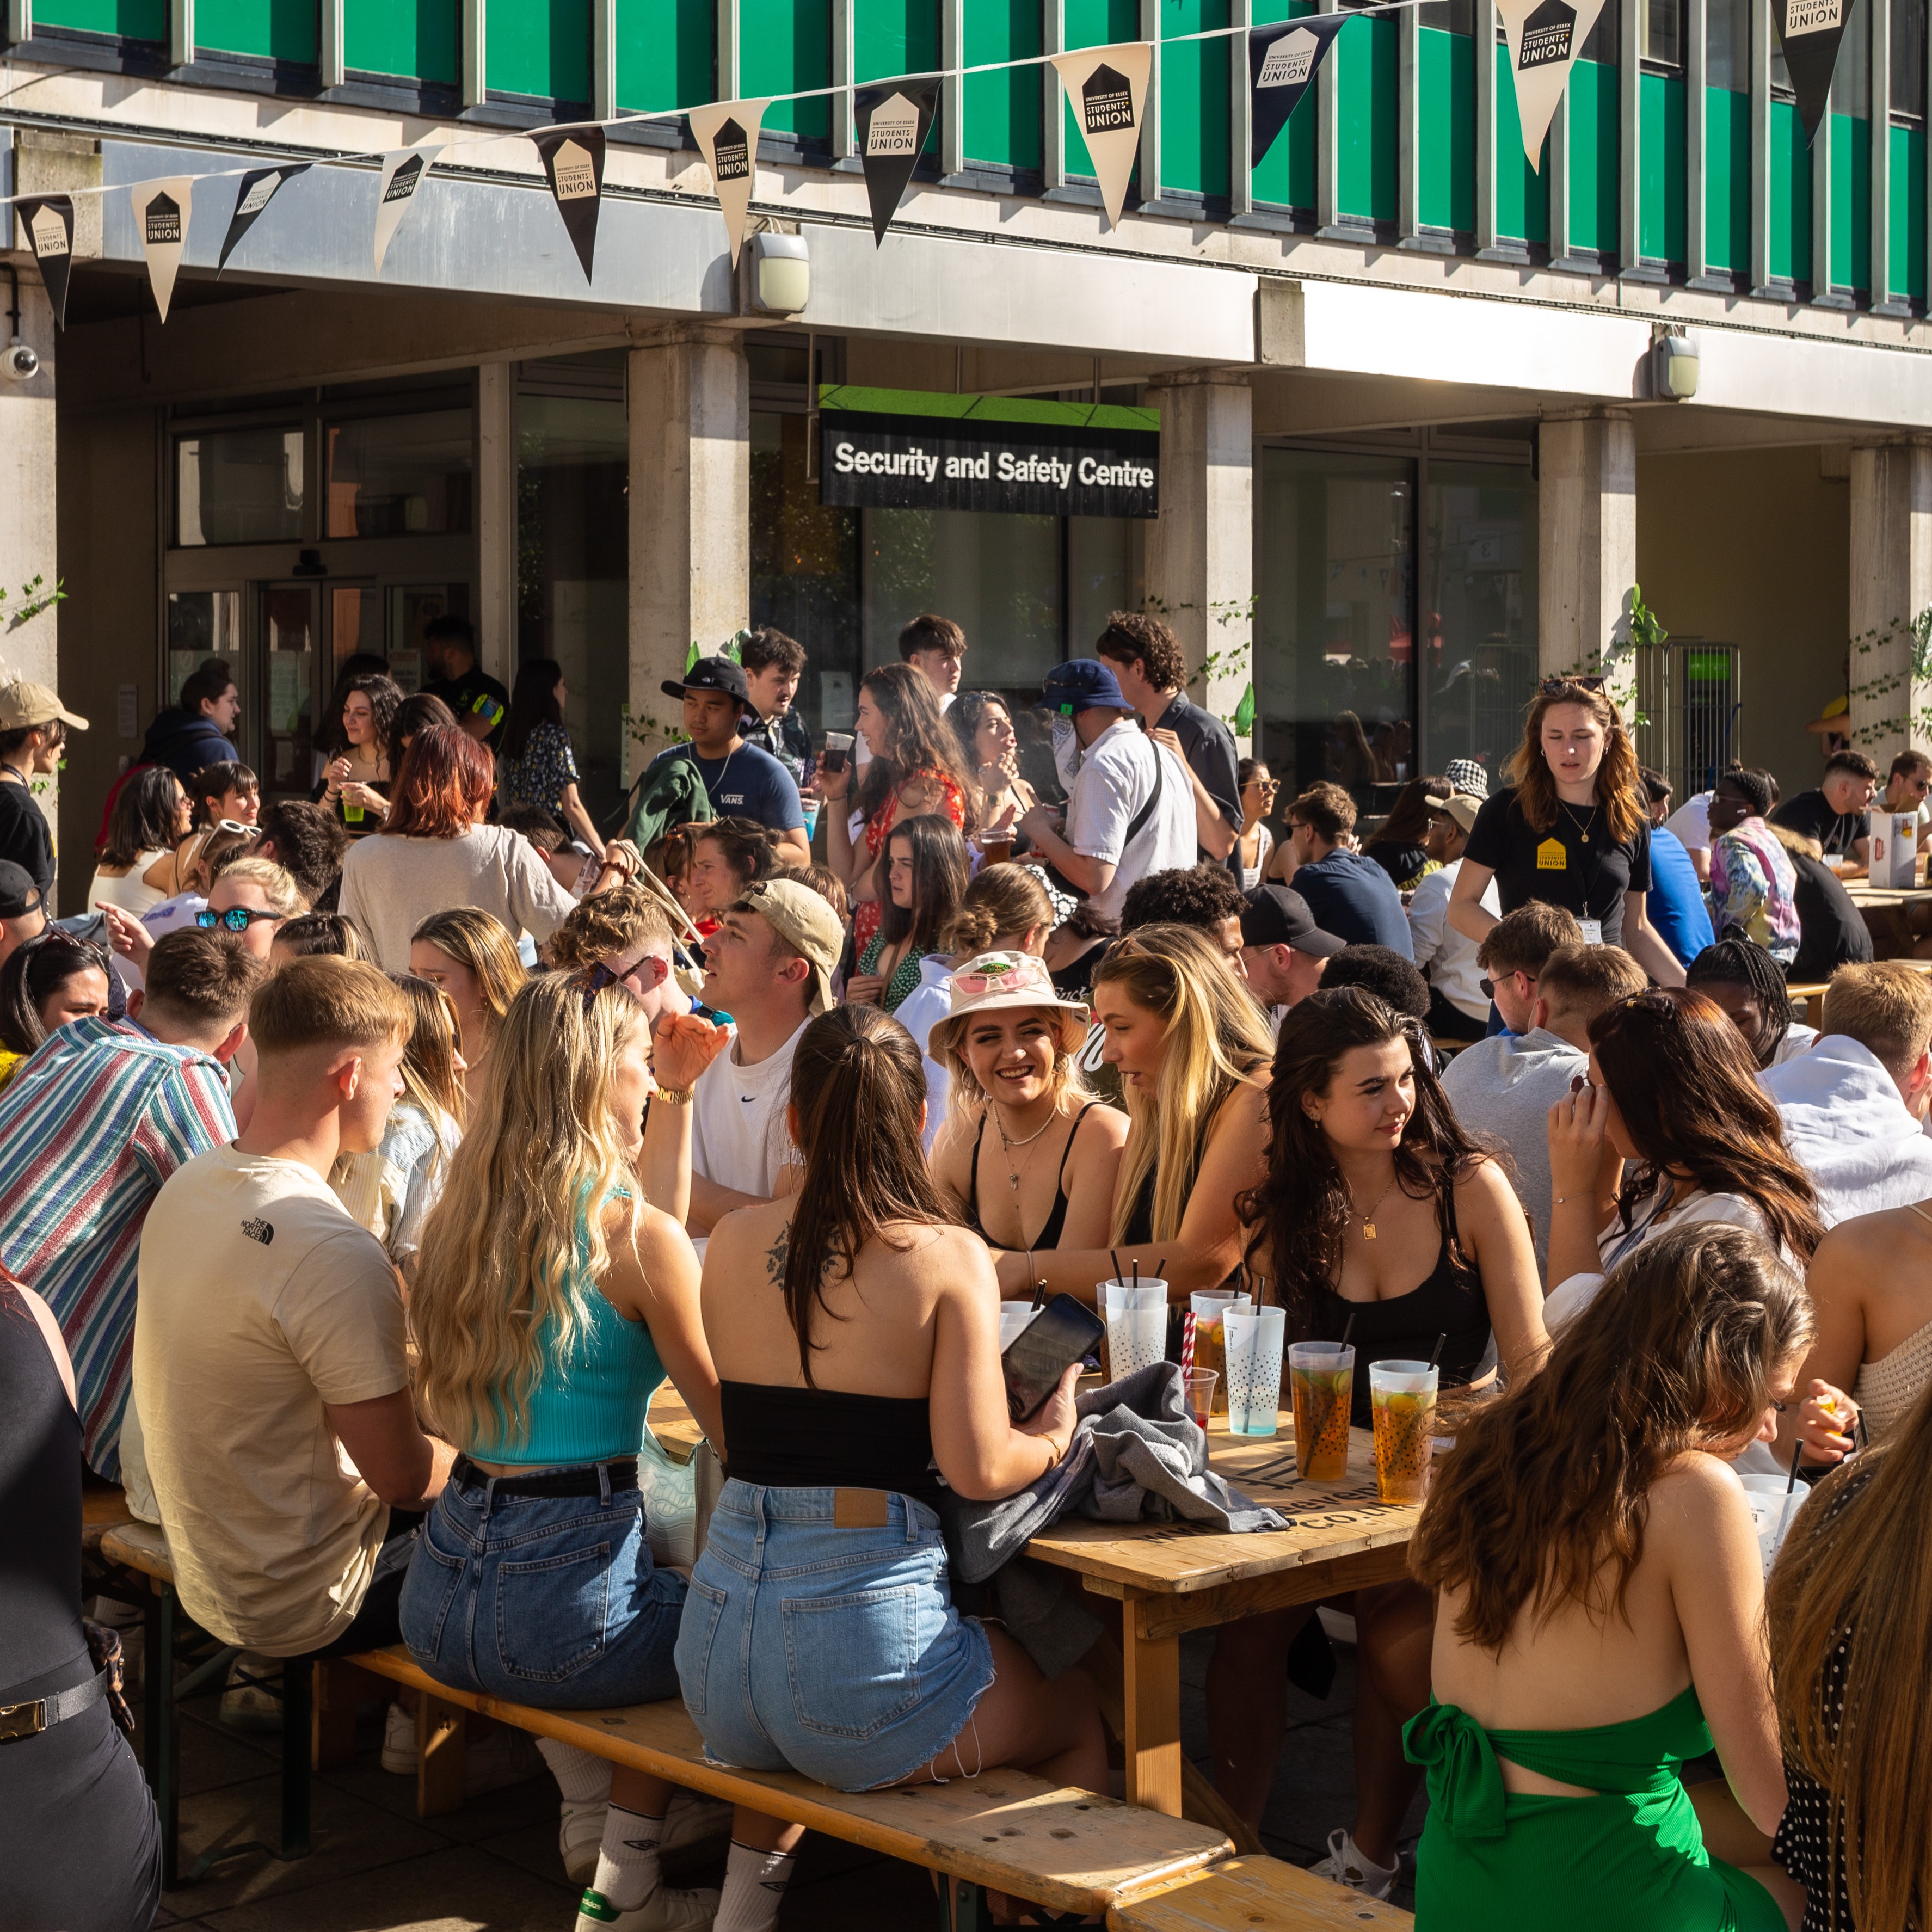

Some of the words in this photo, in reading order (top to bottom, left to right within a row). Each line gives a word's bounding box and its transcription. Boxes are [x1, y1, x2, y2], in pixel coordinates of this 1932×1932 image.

[1789, 7, 1838, 29] UNION
[1525, 27, 1548, 37] UNIVERSITY
[1522, 42, 1568, 63] UNION
[1262, 66, 1308, 82] UNION
[1087, 110, 1131, 128] UNION
[871, 137, 913, 150] UNION
[718, 161, 747, 176] UNION
[386, 183, 414, 199] UNION
[559, 180, 594, 194] UNION
[148, 228, 179, 240] UNION
[38, 239, 66, 253] UNION
[834, 442, 939, 483] Security
[945, 451, 990, 480] and
[996, 452, 1072, 489] Safety
[1076, 457, 1154, 488] Centre
[721, 794, 744, 805] VANS
[240, 1220, 263, 1234] NORTH
[254, 1217, 267, 1228] THE
[242, 1228, 260, 1241] FACE
